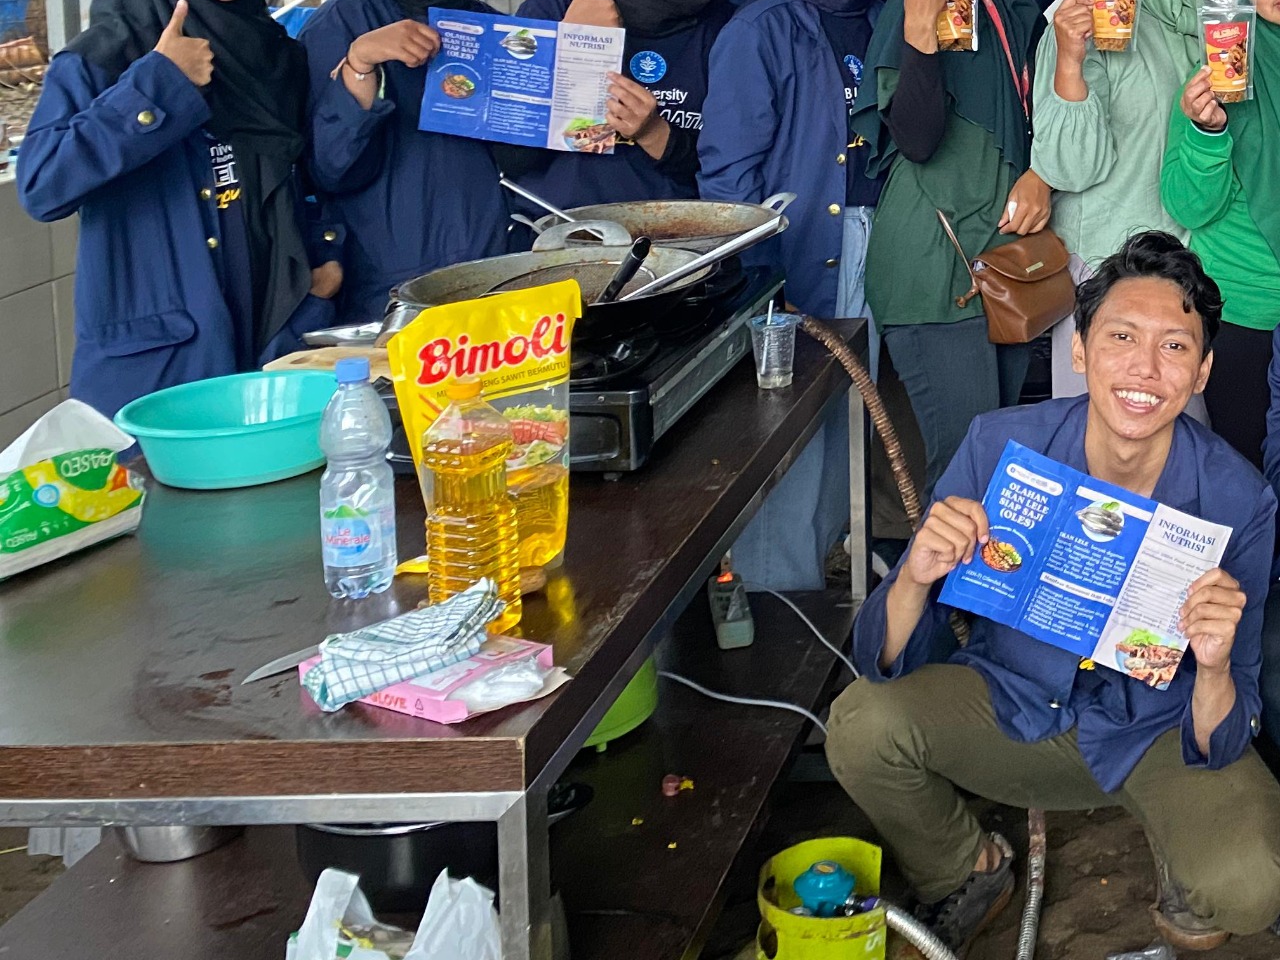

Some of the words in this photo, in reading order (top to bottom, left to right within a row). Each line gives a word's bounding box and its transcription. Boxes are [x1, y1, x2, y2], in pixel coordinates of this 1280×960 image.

[563, 32, 614, 44] INFORMASI
[569, 41, 606, 51] NUTRISI
[416, 313, 569, 385] Bimoli
[501, 371, 525, 384] SAWIT
[528, 361, 567, 377] BERMUTU
[60, 451, 115, 478] PASEO
[1001, 488, 1026, 504] IKAN
[1026, 500, 1049, 515] LELE
[1009, 482, 1049, 504] OLAHAN
[999, 497, 1021, 511] SIAP
[1022, 507, 1044, 522] SAJI
[1000, 508, 1035, 529] (OLES)
[326, 534, 370, 546] Minerale
[338, 526, 351, 537] Le
[1159, 519, 1216, 546] INFORMASI
[1162, 531, 1206, 553] NUTRISI
